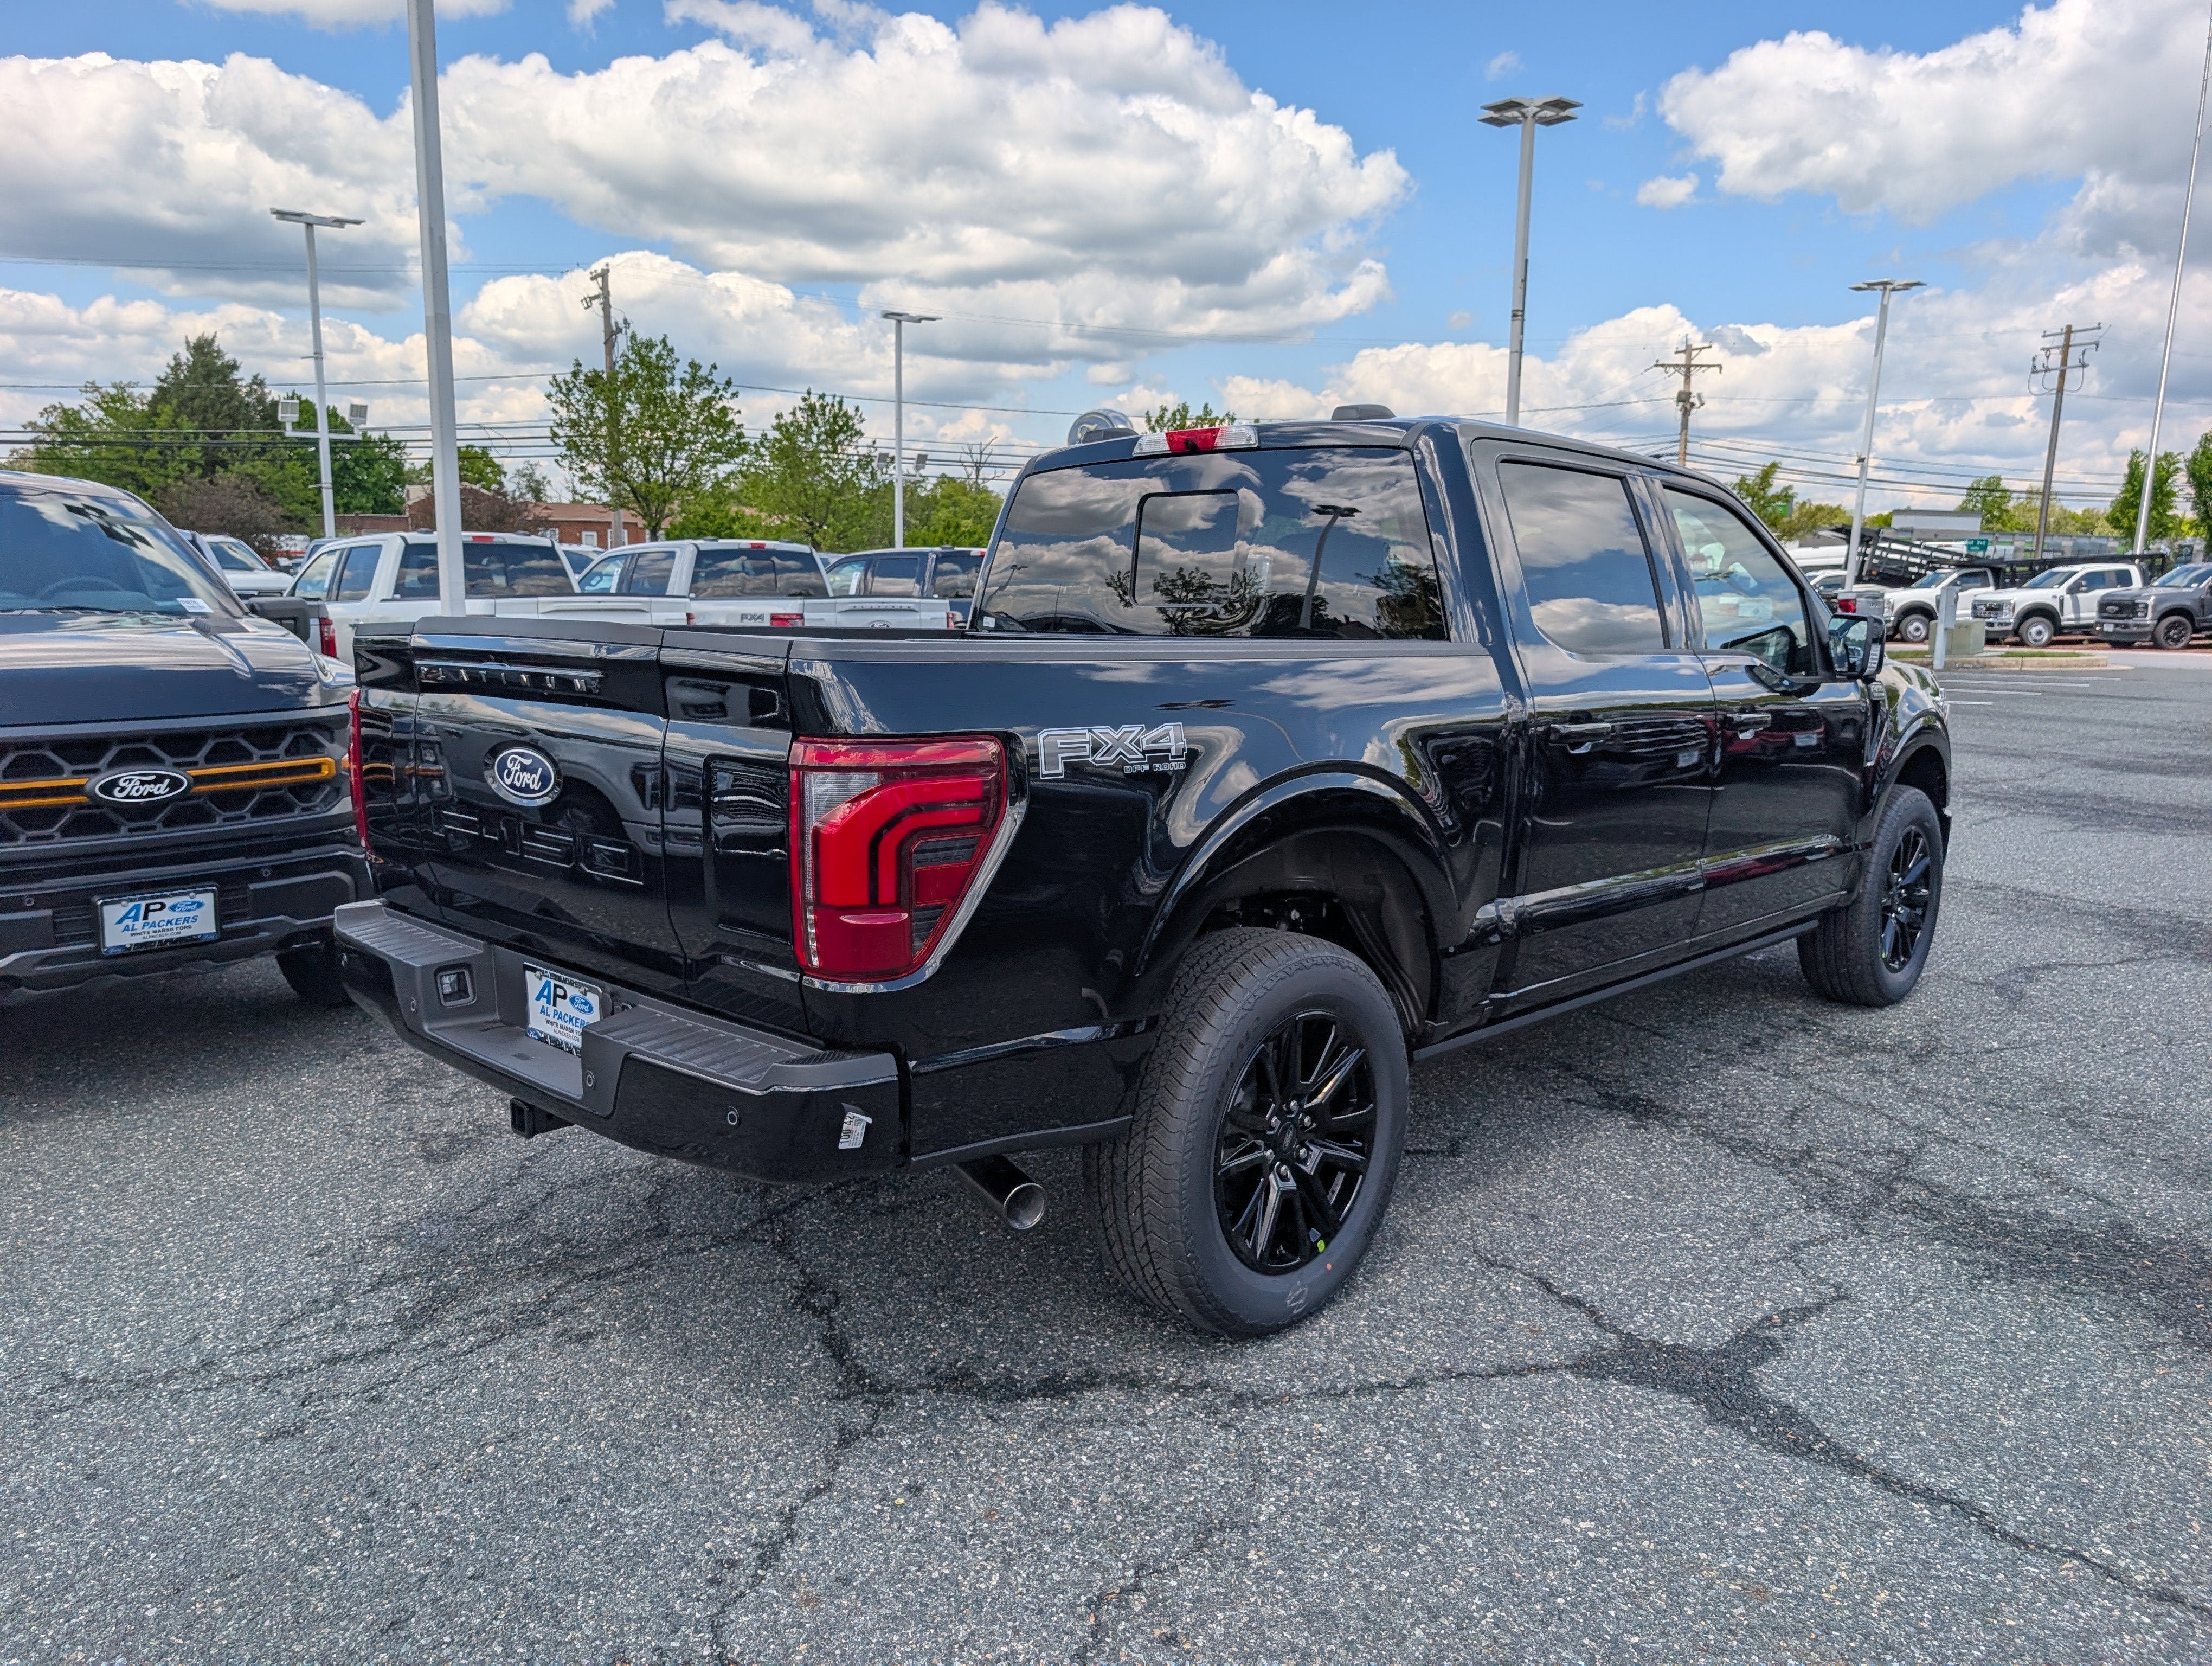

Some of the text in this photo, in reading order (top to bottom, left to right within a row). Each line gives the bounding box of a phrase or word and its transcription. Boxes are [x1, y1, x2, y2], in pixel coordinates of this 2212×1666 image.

[420, 667, 587, 692] PLATINUM
[1037, 722, 1187, 779] FX4
[503, 754, 542, 791] Ford
[1124, 762, 1186, 773] OFF ROAD
[113, 775, 171, 798] Ford
[917, 854, 964, 864] FORD
[114, 901, 197, 925] AP Ford
[121, 915, 198, 933] AL PACKERS
[142, 931, 182, 940] ALPACKER.COM
[535, 979, 589, 1013] AP Ford
[539, 1005, 550, 1017] AL
[545, 1018, 559, 1028] WHITE
[560, 1023, 574, 1034] MARSH
[553, 1028, 580, 1042] ALPACKER.COM
